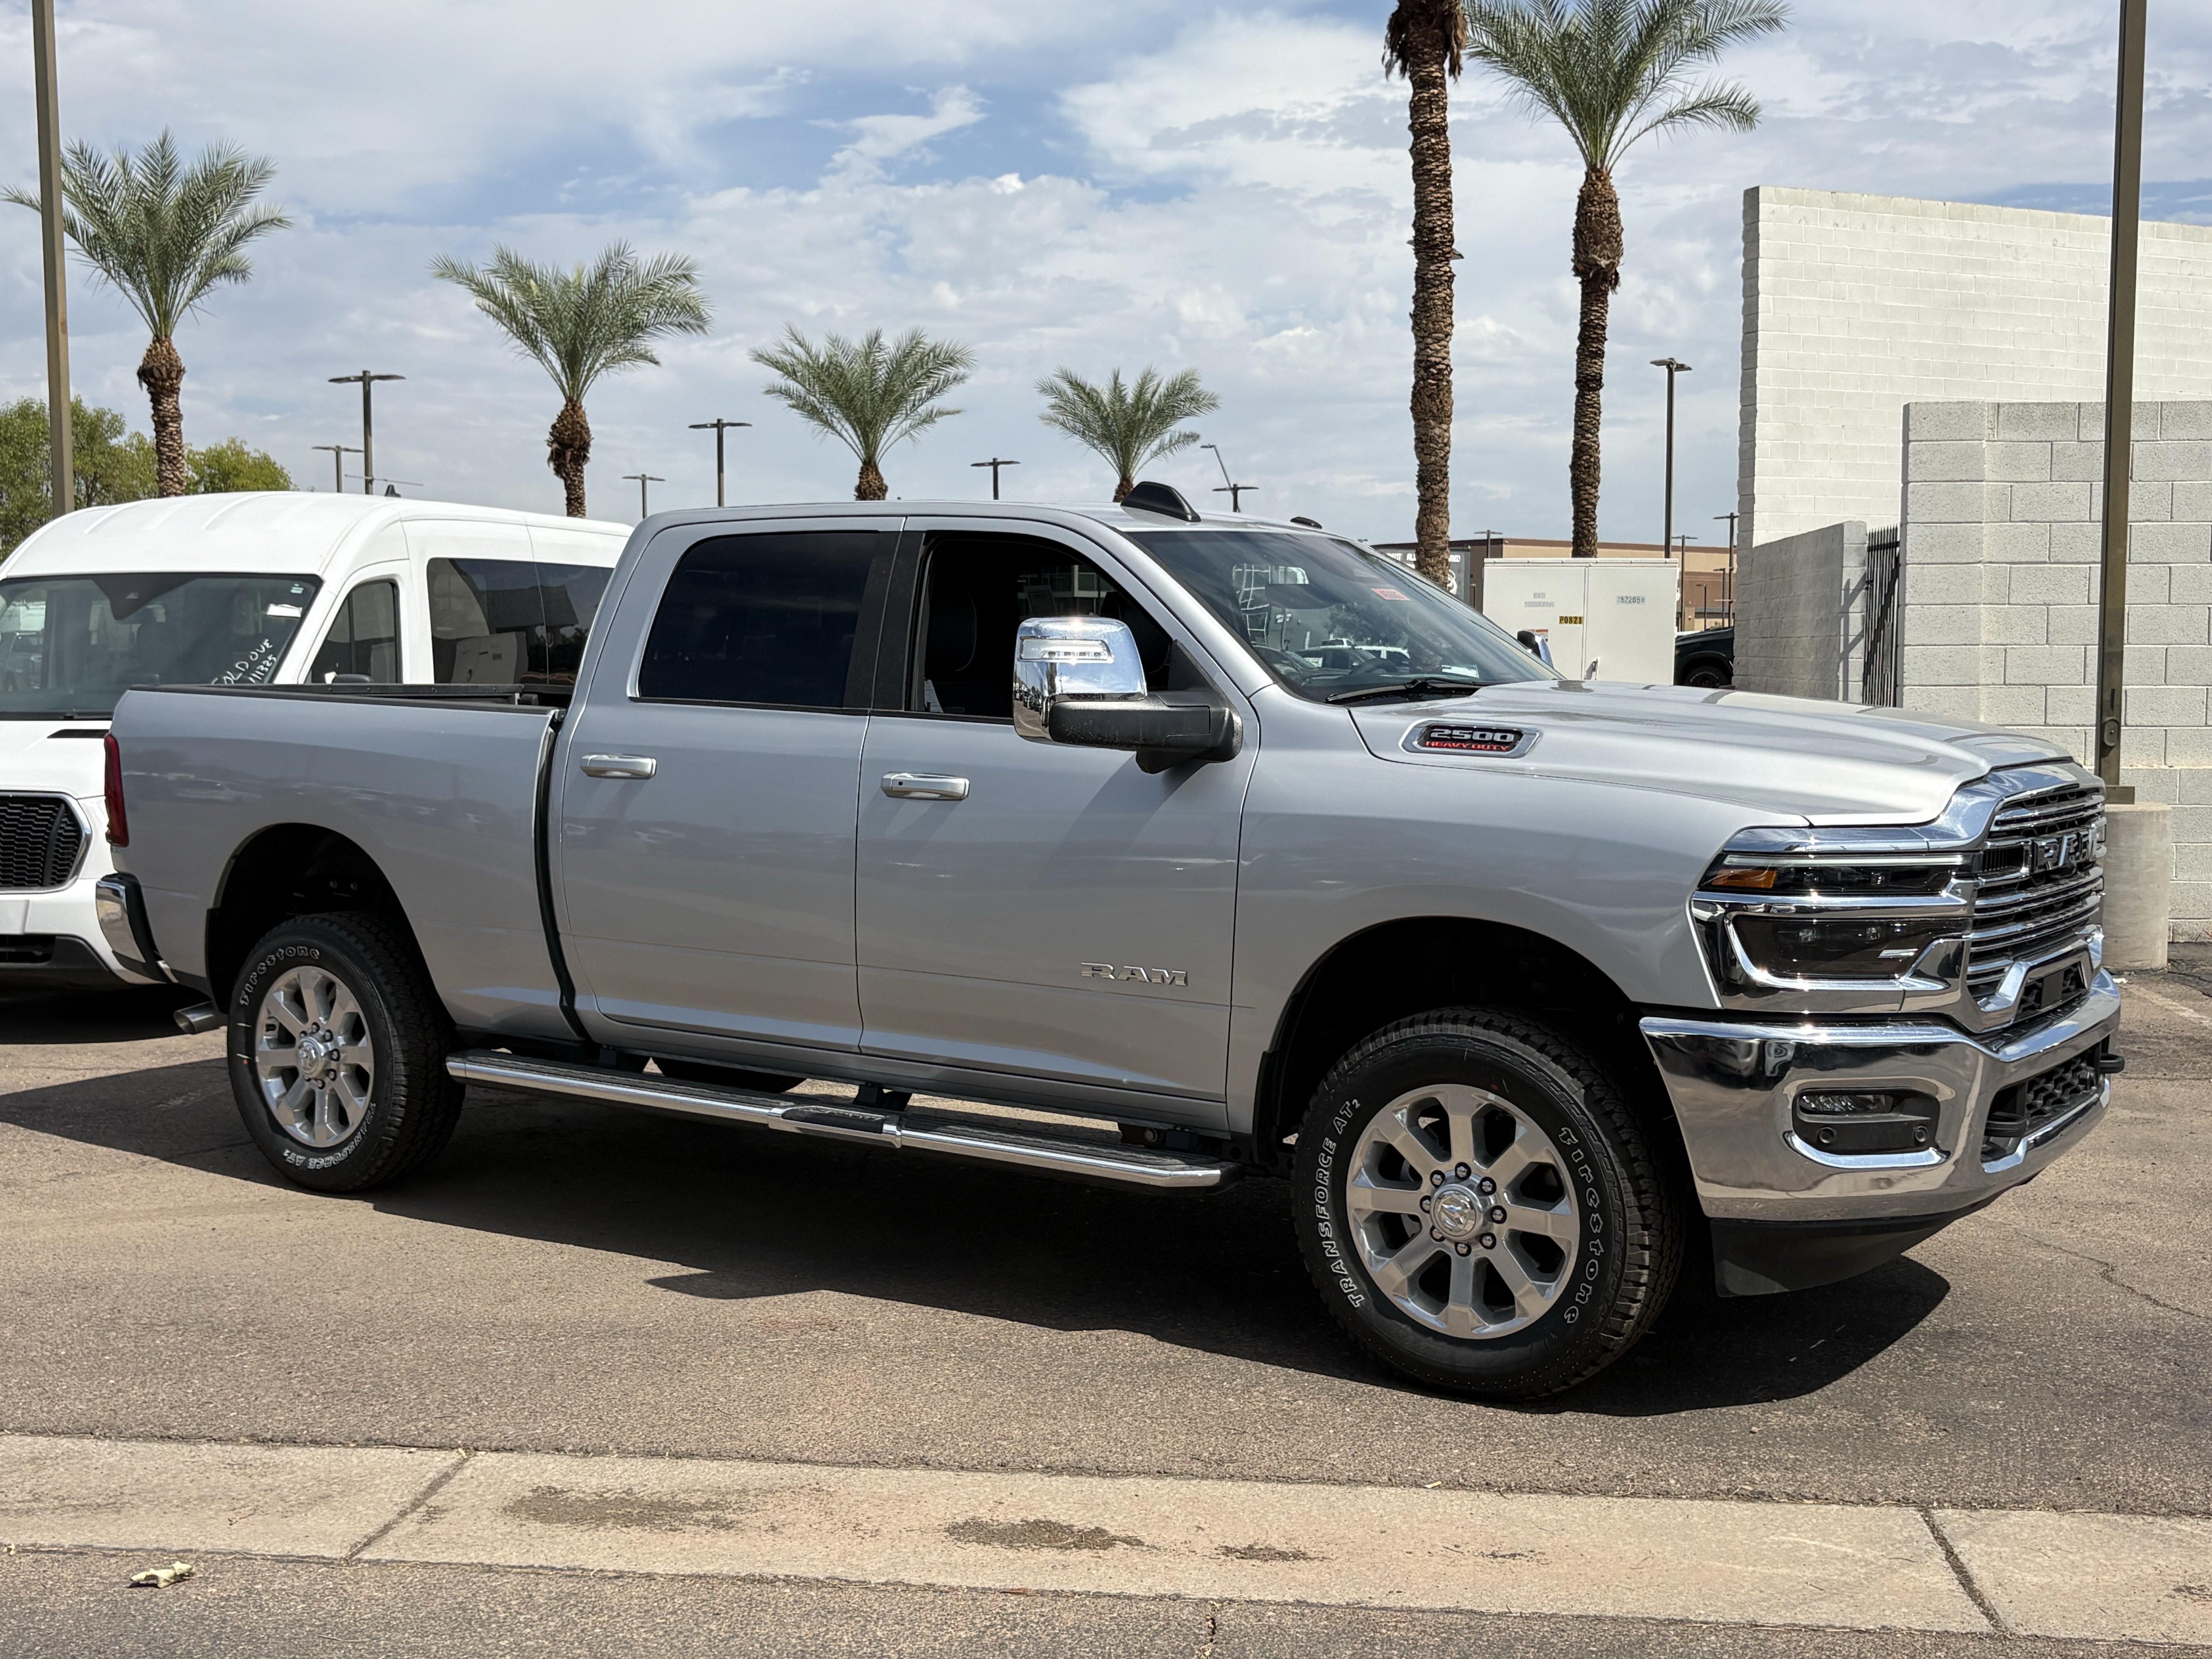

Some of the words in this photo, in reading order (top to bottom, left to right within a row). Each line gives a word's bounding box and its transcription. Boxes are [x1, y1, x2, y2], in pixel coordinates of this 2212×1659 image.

[1559, 616, 1582, 624] P0821
[1430, 728, 1514, 742] 2500
[1471, 743, 1509, 752] DUTY
[240, 946, 320, 1006] Firestone
[1081, 962, 1188, 986] RAM
[1333, 1099, 1361, 1135] AT2
[307, 1103, 376, 1169] TRANSFORCE
[1315, 1137, 1365, 1308] TRANSFORCE
[1559, 1127, 1604, 1323] Firestone
